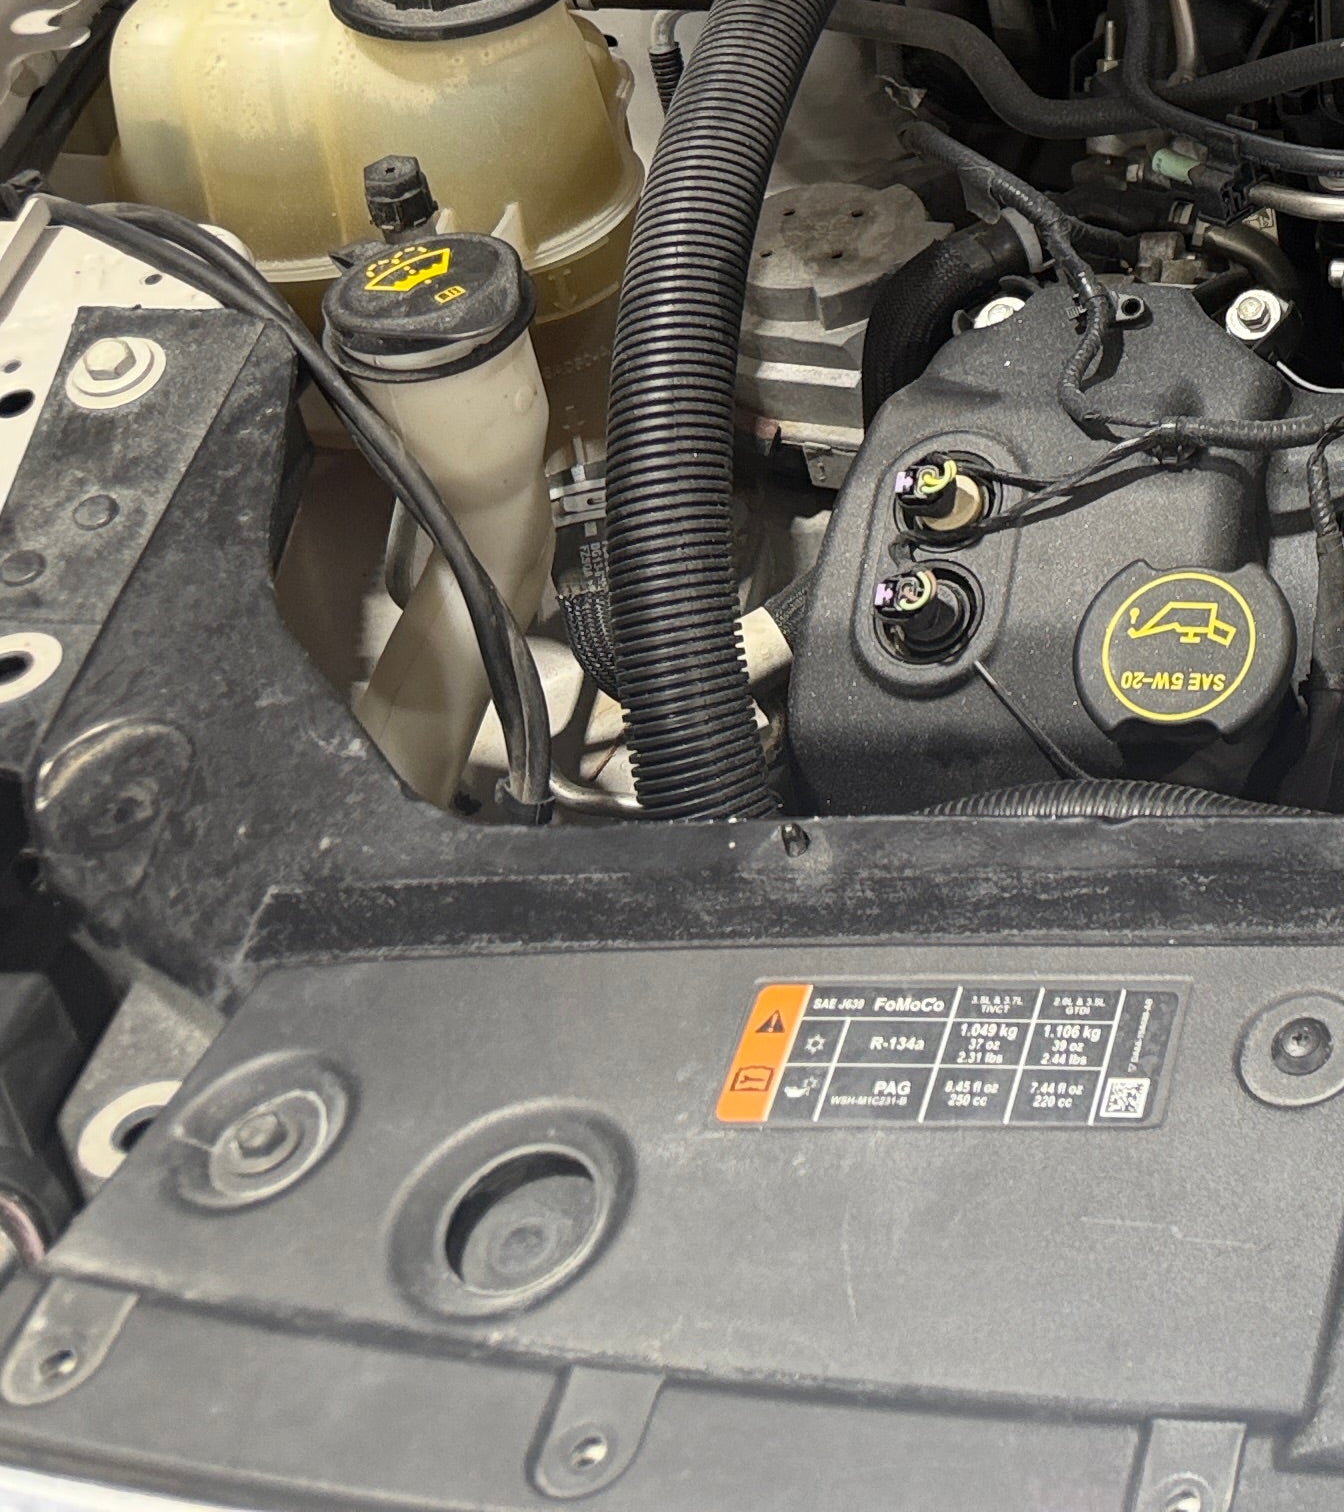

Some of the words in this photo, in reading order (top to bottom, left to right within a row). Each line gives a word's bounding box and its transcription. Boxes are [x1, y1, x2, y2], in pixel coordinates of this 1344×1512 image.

[1120, 671, 1185, 690] 5W-20
[1188, 672, 1226, 692] SAE
[812, 998, 839, 1010] SAE
[874, 996, 945, 1013] FoMoCo
[960, 1022, 998, 1037] 1.049
[999, 1023, 1019, 1041] kg
[1043, 1024, 1081, 1039] 1.106
[1082, 1025, 1102, 1043] kg
[869, 1036, 925, 1051] R-134a
[968, 1038, 982, 1051] 37
[985, 1040, 1001, 1051] oz
[1051, 1039, 1068, 1052] 39
[1069, 1041, 1085, 1053] oz
[956, 1051, 982, 1064] 2.31
[984, 1052, 1003, 1064] lbs
[1040, 1052, 1067, 1065] 2.44
[1068, 1053, 1087, 1066] lbs
[873, 1080, 912, 1096] PAG
[944, 1080, 971, 1093] 8.45
[972, 1080, 982, 1093] fl
[983, 1082, 999, 1094] oz
[1029, 1081, 1056, 1094] 7.44
[1057, 1081, 1067, 1094] fl
[1068, 1083, 1085, 1096] oz
[947, 1093, 971, 1106] 250
[972, 1095, 988, 1107] cc
[1032, 1094, 1056, 1108] 220
[1057, 1097, 1073, 1108] cc
